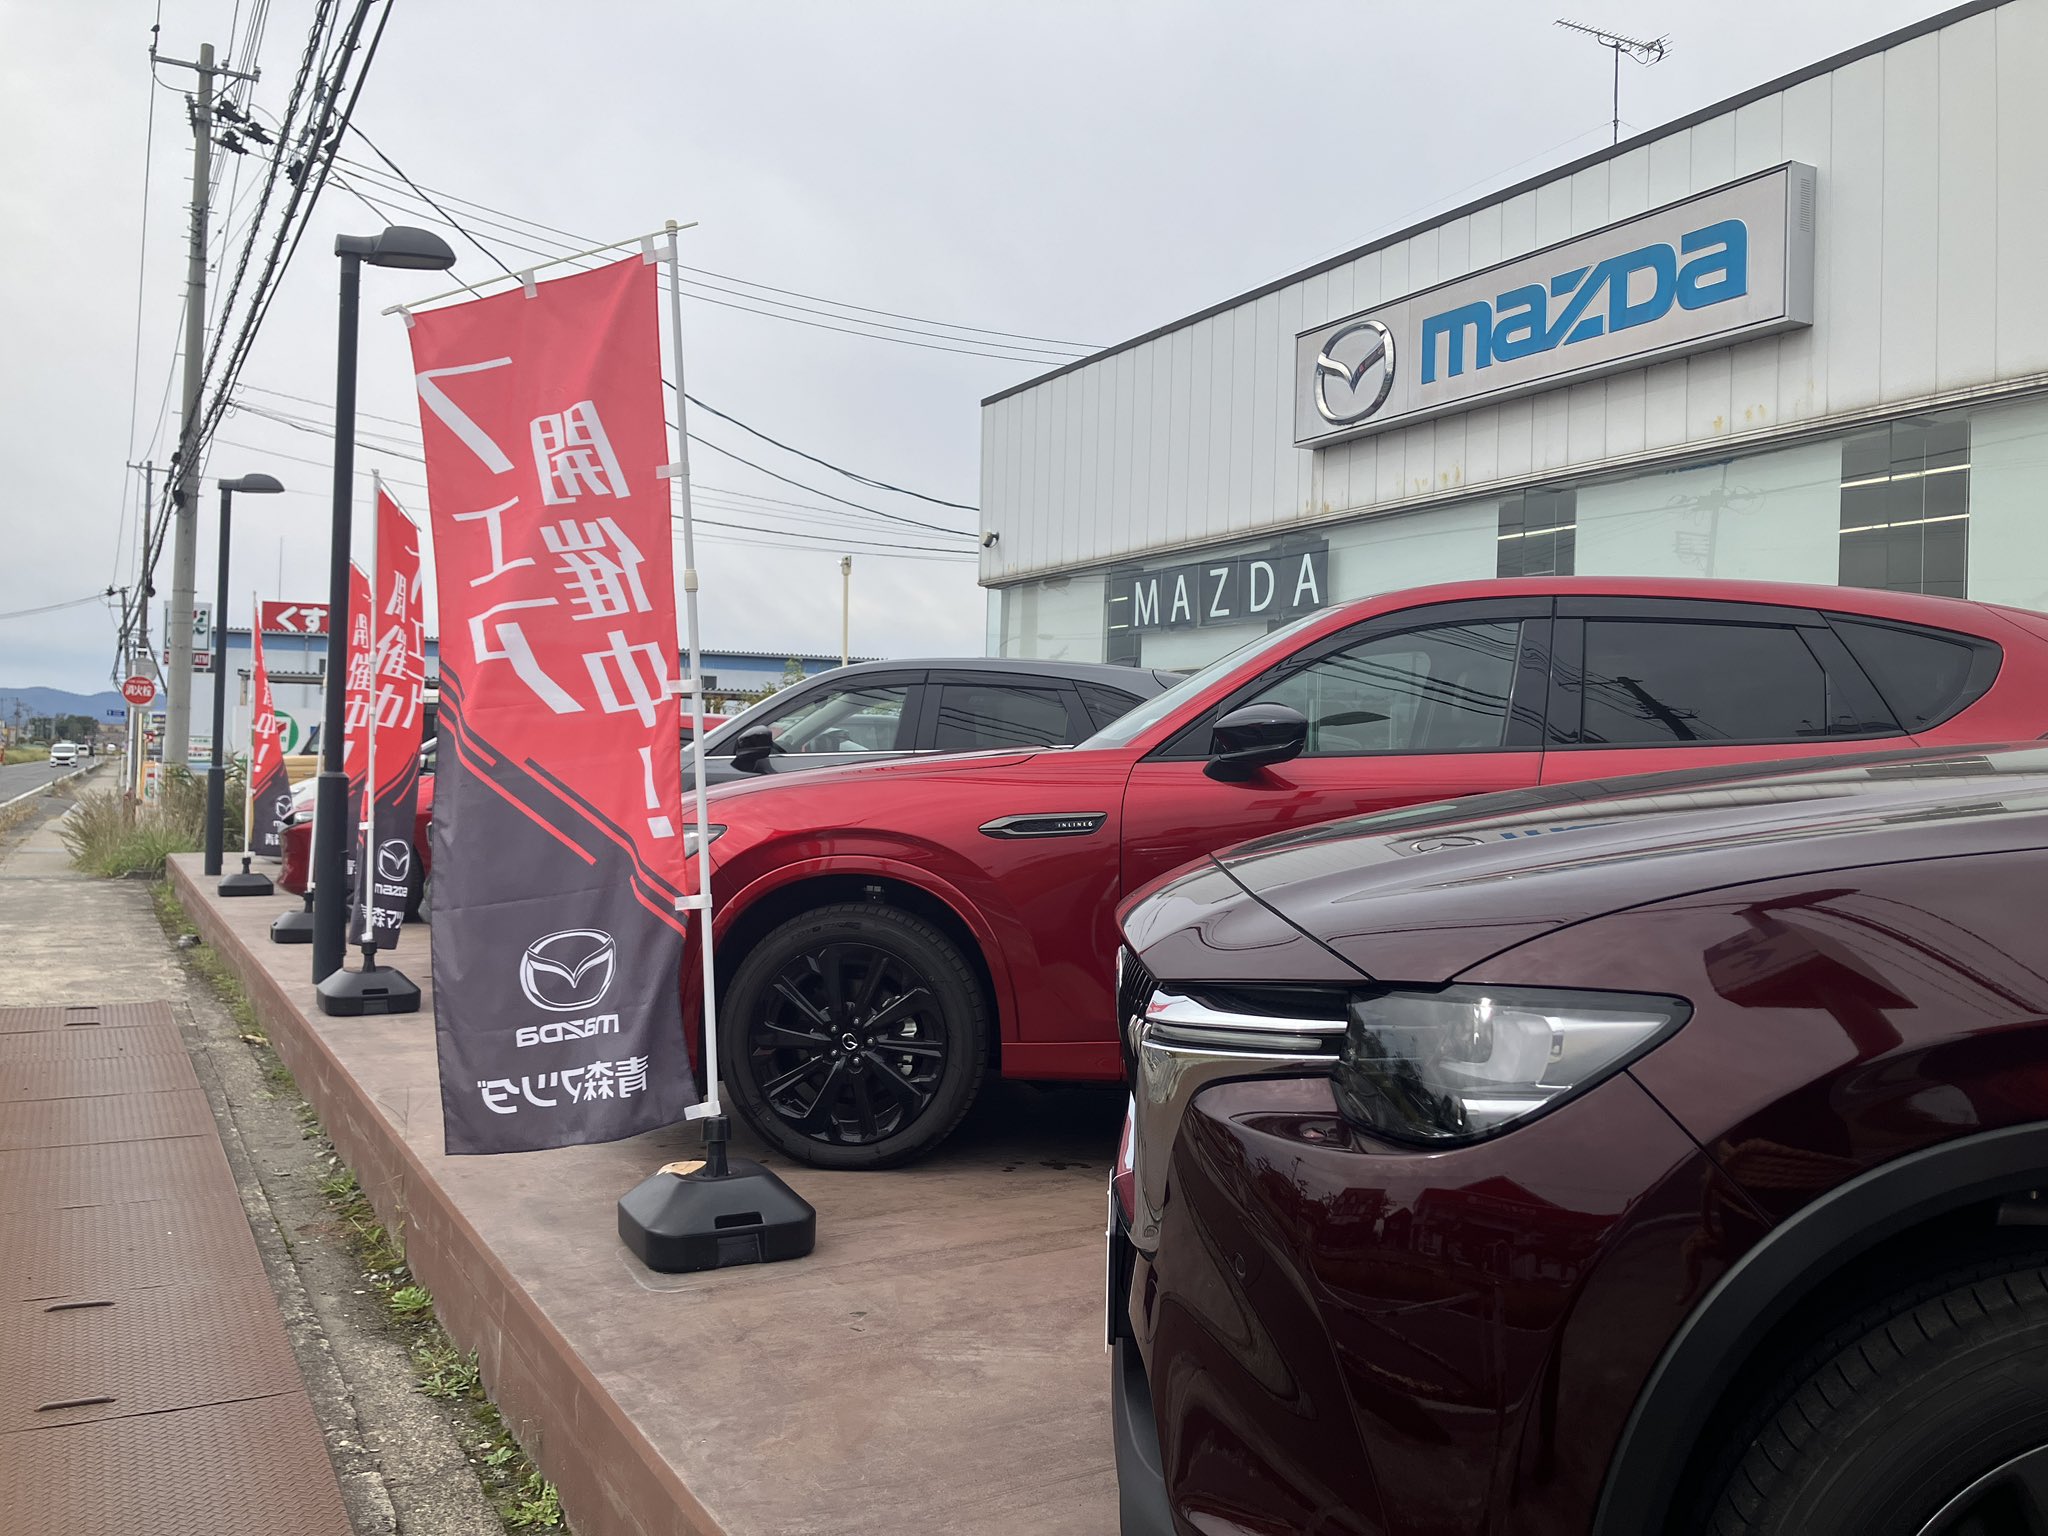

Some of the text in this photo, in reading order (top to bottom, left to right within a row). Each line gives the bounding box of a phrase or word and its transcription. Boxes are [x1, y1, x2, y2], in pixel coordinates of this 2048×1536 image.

[1134, 553, 1320, 627] MAZDA
[194, 654, 209, 665] ATM
[125, 684, 152, 697] 消火栓
